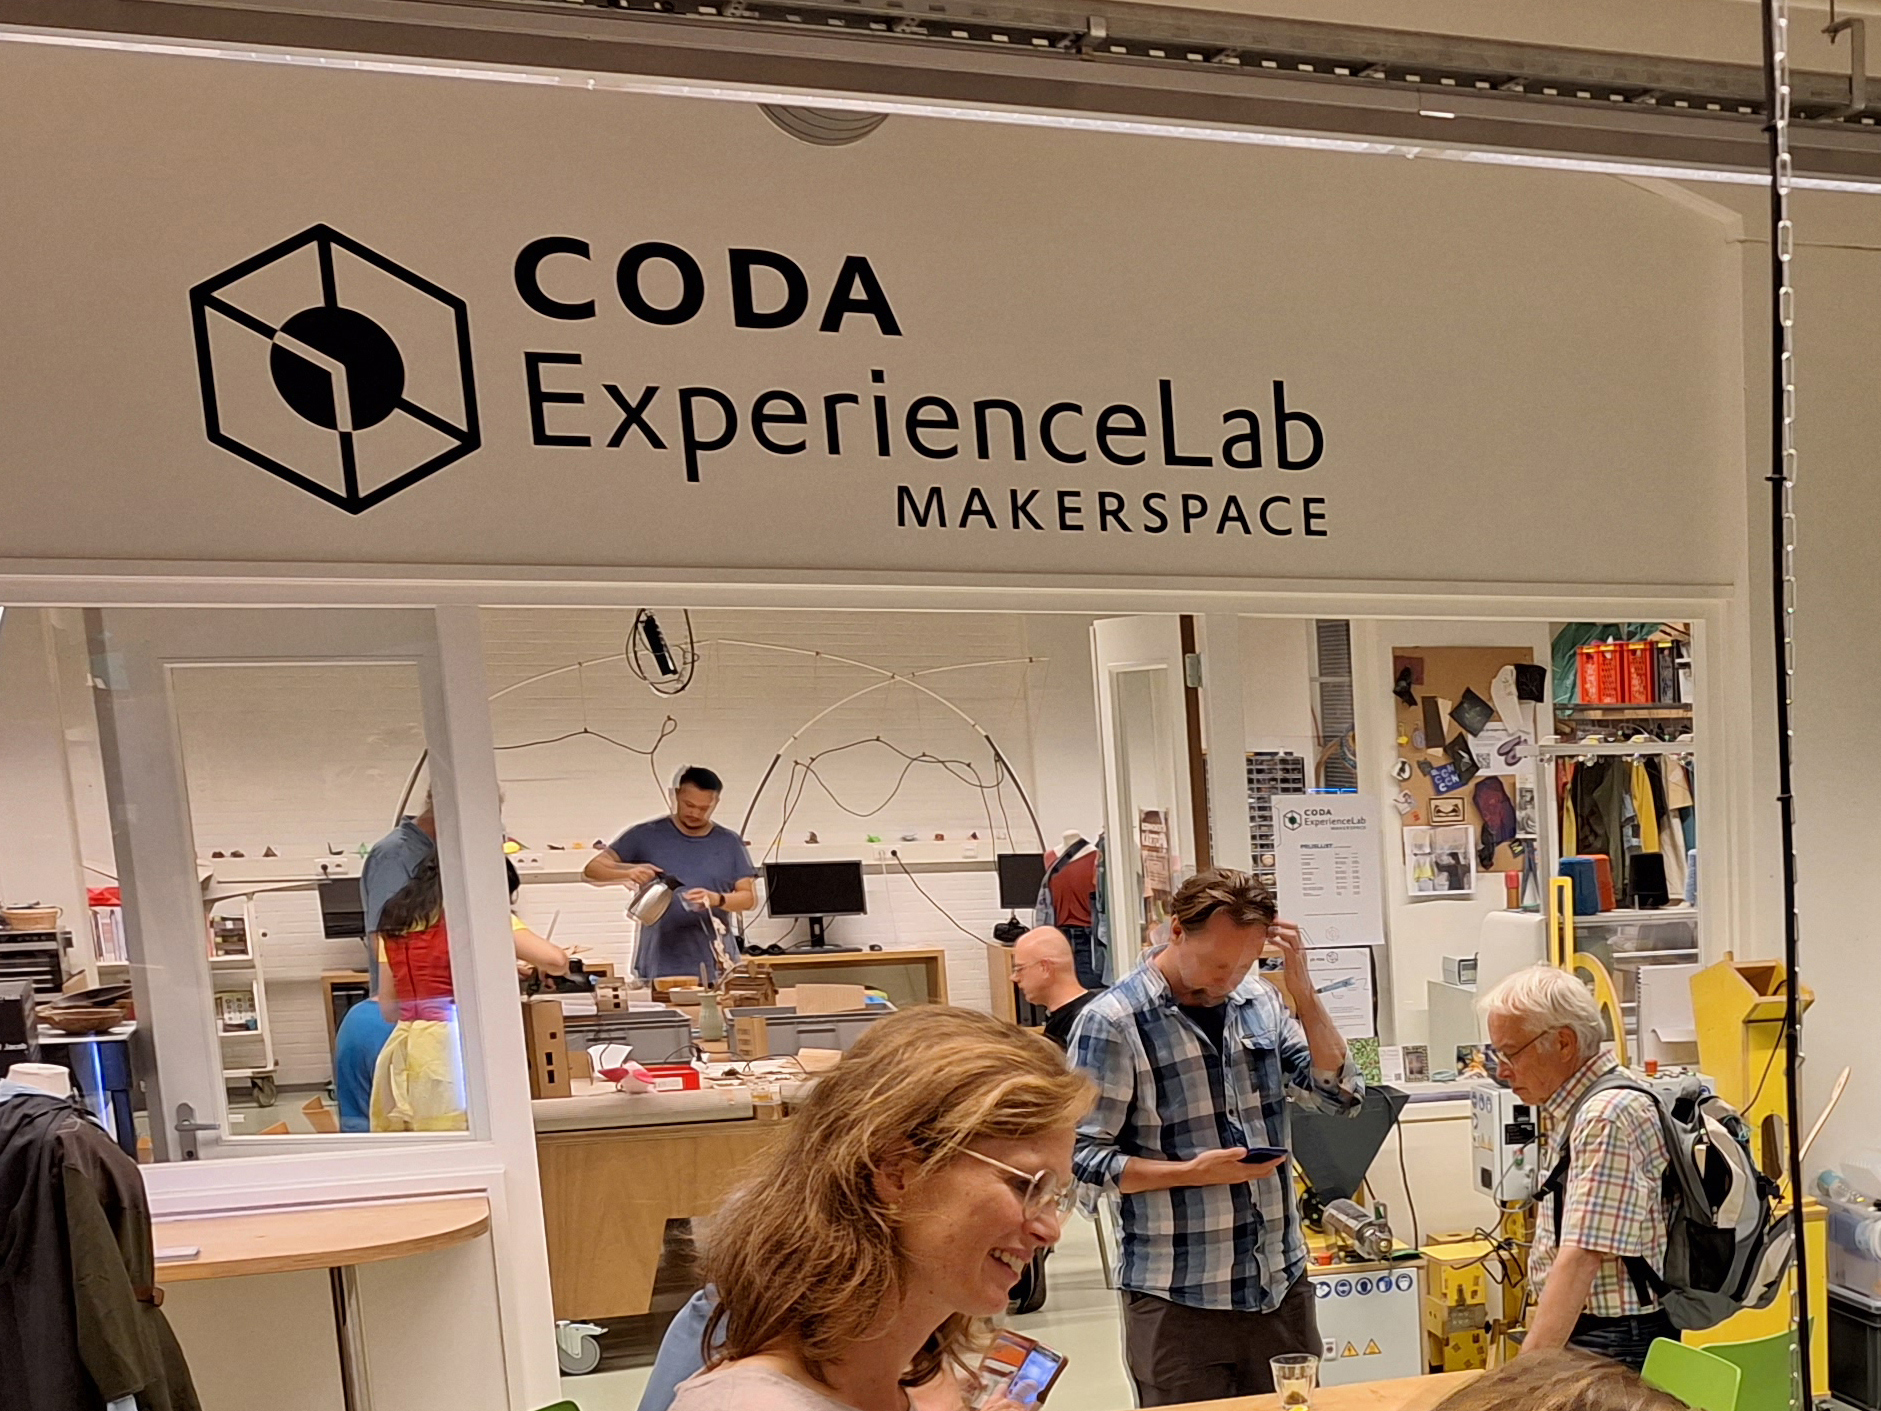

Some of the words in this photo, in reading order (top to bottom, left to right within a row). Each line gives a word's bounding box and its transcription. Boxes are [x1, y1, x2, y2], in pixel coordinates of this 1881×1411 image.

[514, 236, 903, 337] CODA
[523, 351, 1324, 483] ExperienceLab
[897, 485, 1328, 537] MAKERSPACE
[1303, 808, 1332, 816] CODA
[1304, 816, 1366, 828] ExperienceLab
